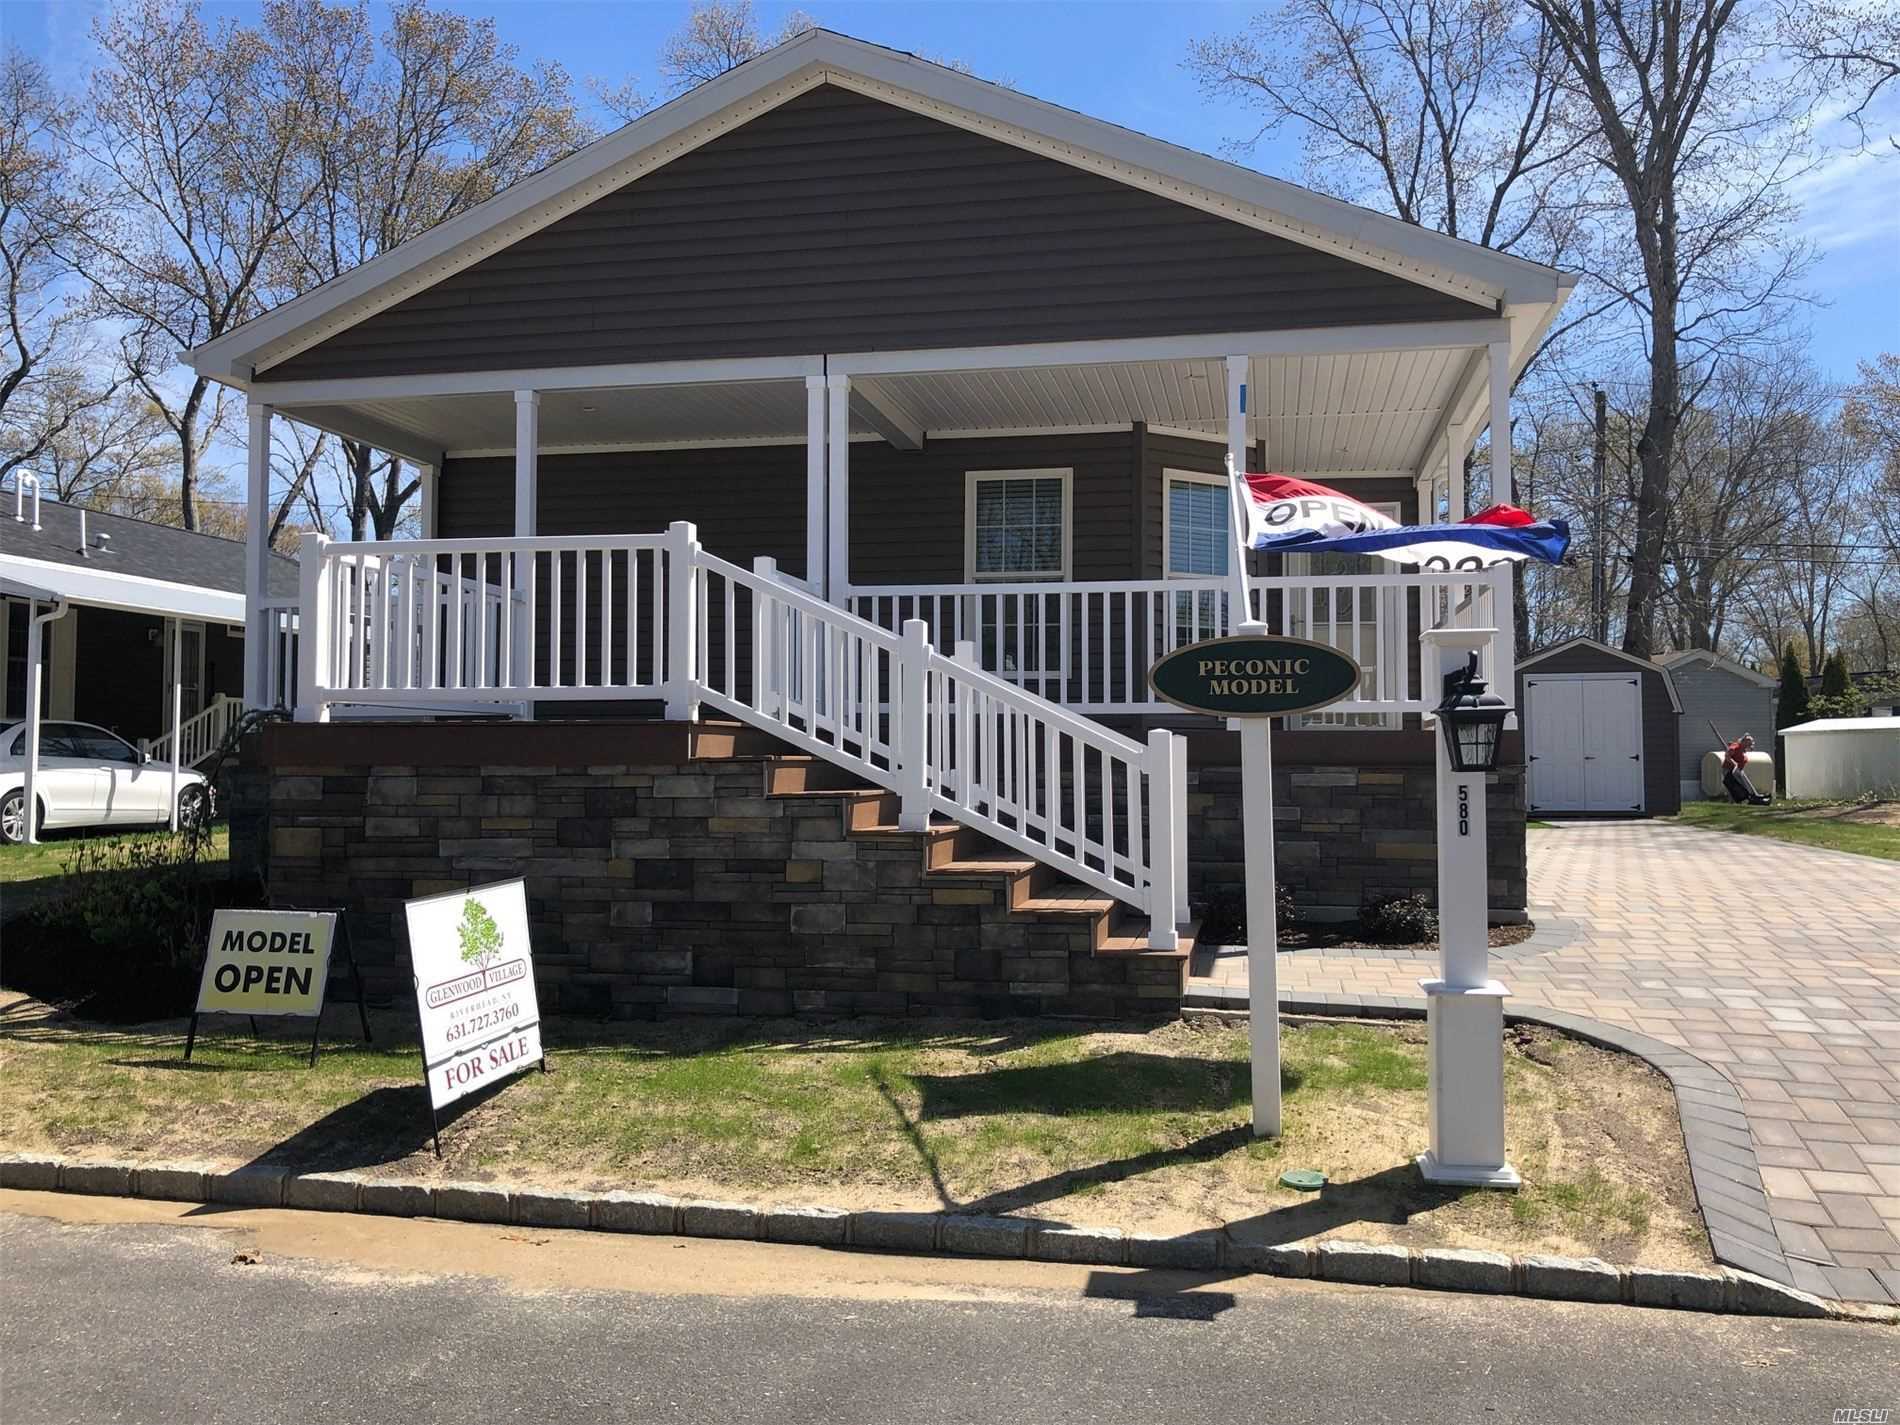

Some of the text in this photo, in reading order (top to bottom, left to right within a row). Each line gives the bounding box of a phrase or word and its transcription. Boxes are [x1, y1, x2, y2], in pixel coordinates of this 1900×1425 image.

[1199, 658, 1310, 677] PECONIC
[1209, 679, 1299, 696] MODEL
[1458, 785, 1470, 836] 580
[221, 930, 314, 954] MODEL
[214, 964, 313, 995] OPEN
[430, 963, 523, 1003] GLENWOOD VILLAGE
[446, 1002, 519, 1042] 631.727.3760
[445, 1036, 529, 1090] FOR SALE
